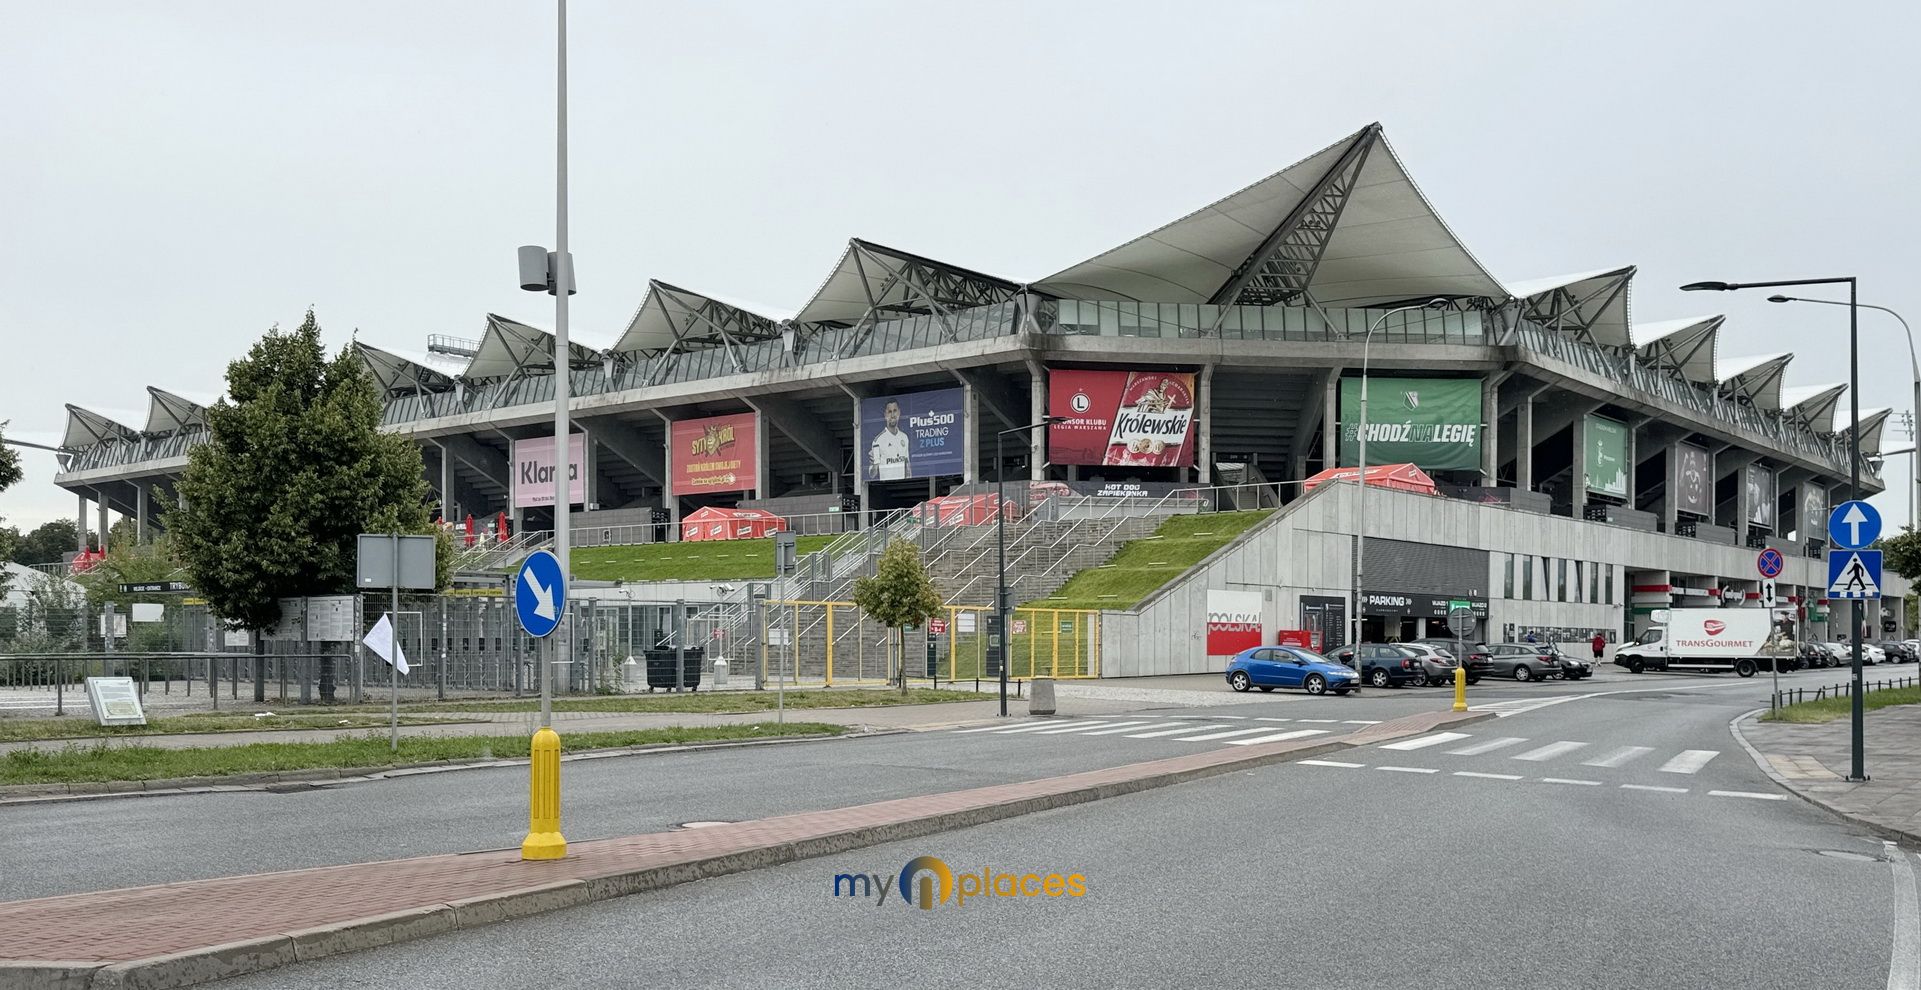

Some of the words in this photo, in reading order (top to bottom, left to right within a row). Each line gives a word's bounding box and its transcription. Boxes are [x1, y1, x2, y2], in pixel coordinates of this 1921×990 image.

[1077, 397, 1085, 409] L
[909, 413, 955, 428] Plus500
[1085, 418, 1107, 426] KLUBU
[1114, 413, 1187, 439] Królewskie
[916, 427, 949, 439] TRADING
[926, 438, 945, 448] PLUS
[521, 461, 577, 485] Klara
[1369, 595, 1404, 606] PARKING
[1676, 639, 1754, 648] TRANSGOURMET
